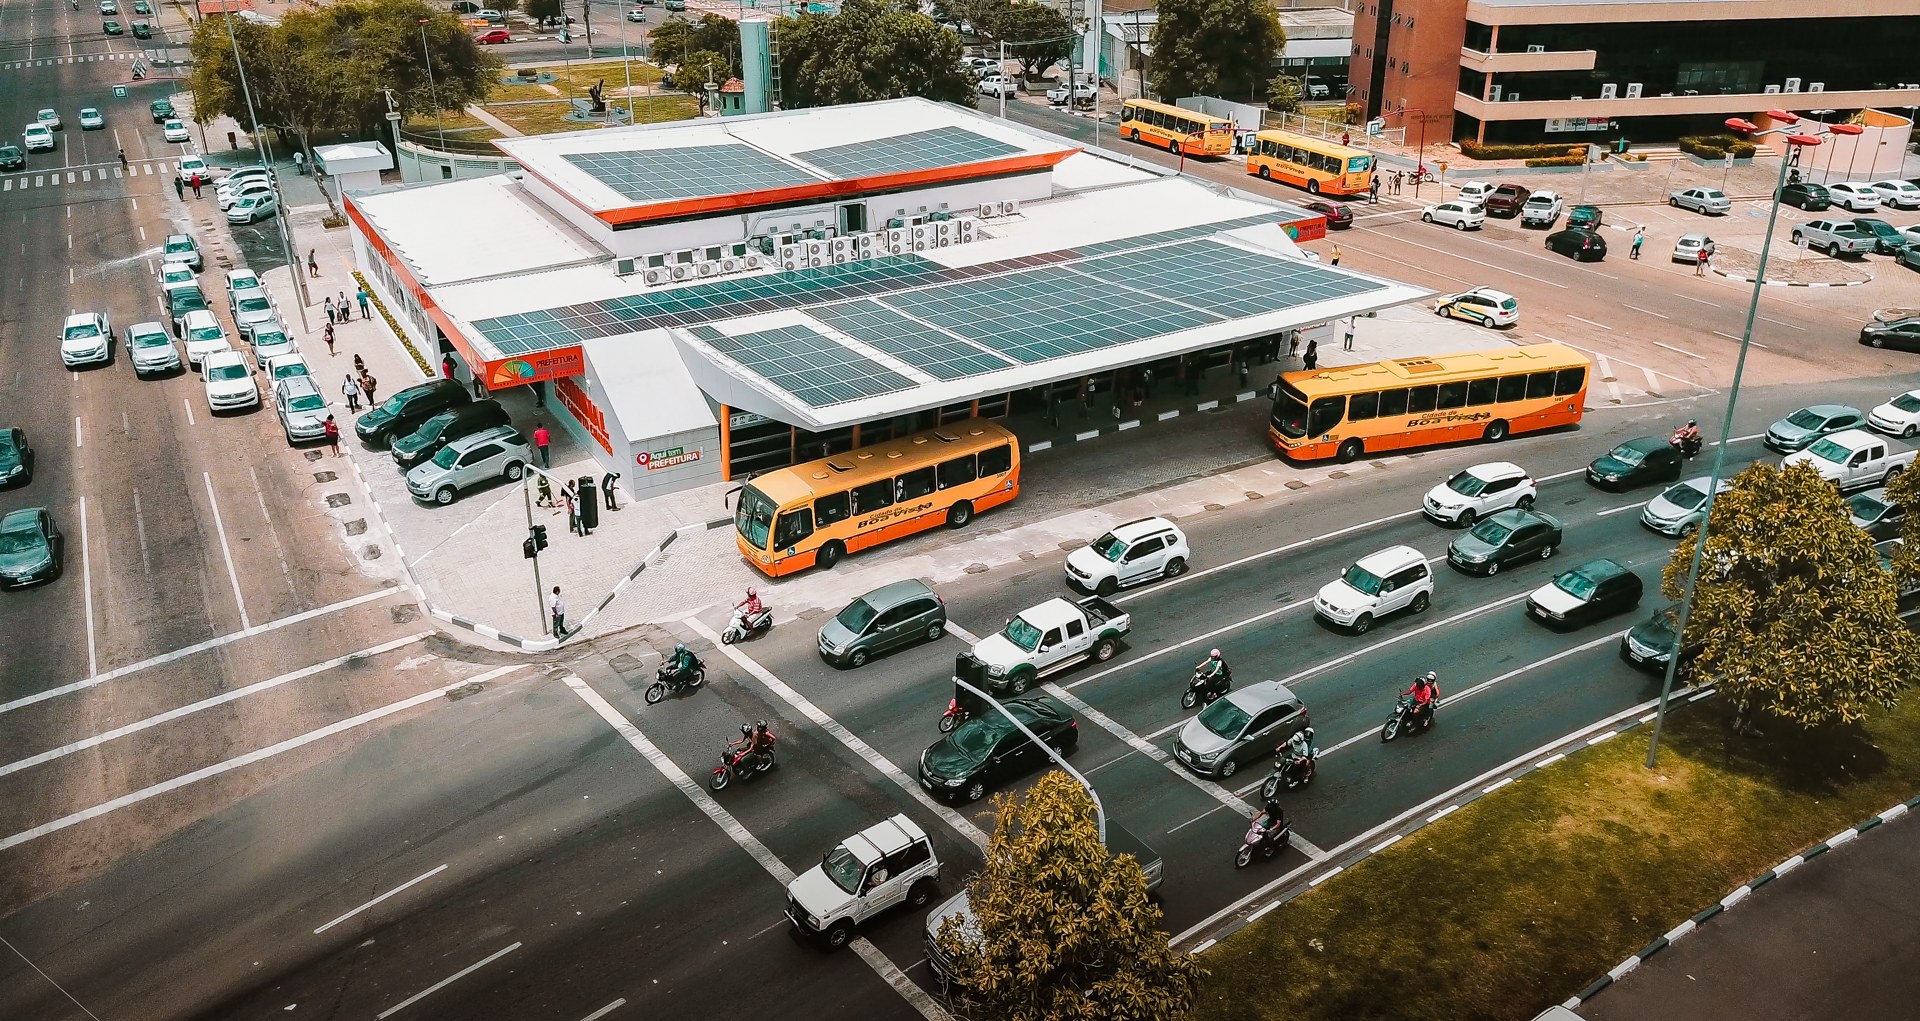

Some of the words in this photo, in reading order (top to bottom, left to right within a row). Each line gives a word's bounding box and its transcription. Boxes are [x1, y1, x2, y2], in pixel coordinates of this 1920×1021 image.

[536, 354, 579, 367] PREFEITURA
[1407, 417, 1441, 428] Boa
[1446, 412, 1491, 422] Vista
[1421, 411, 1447, 419] Cidade
[650, 450, 667, 460] Aqui
[667, 448, 682, 457] tem
[857, 515, 890, 529] Boa
